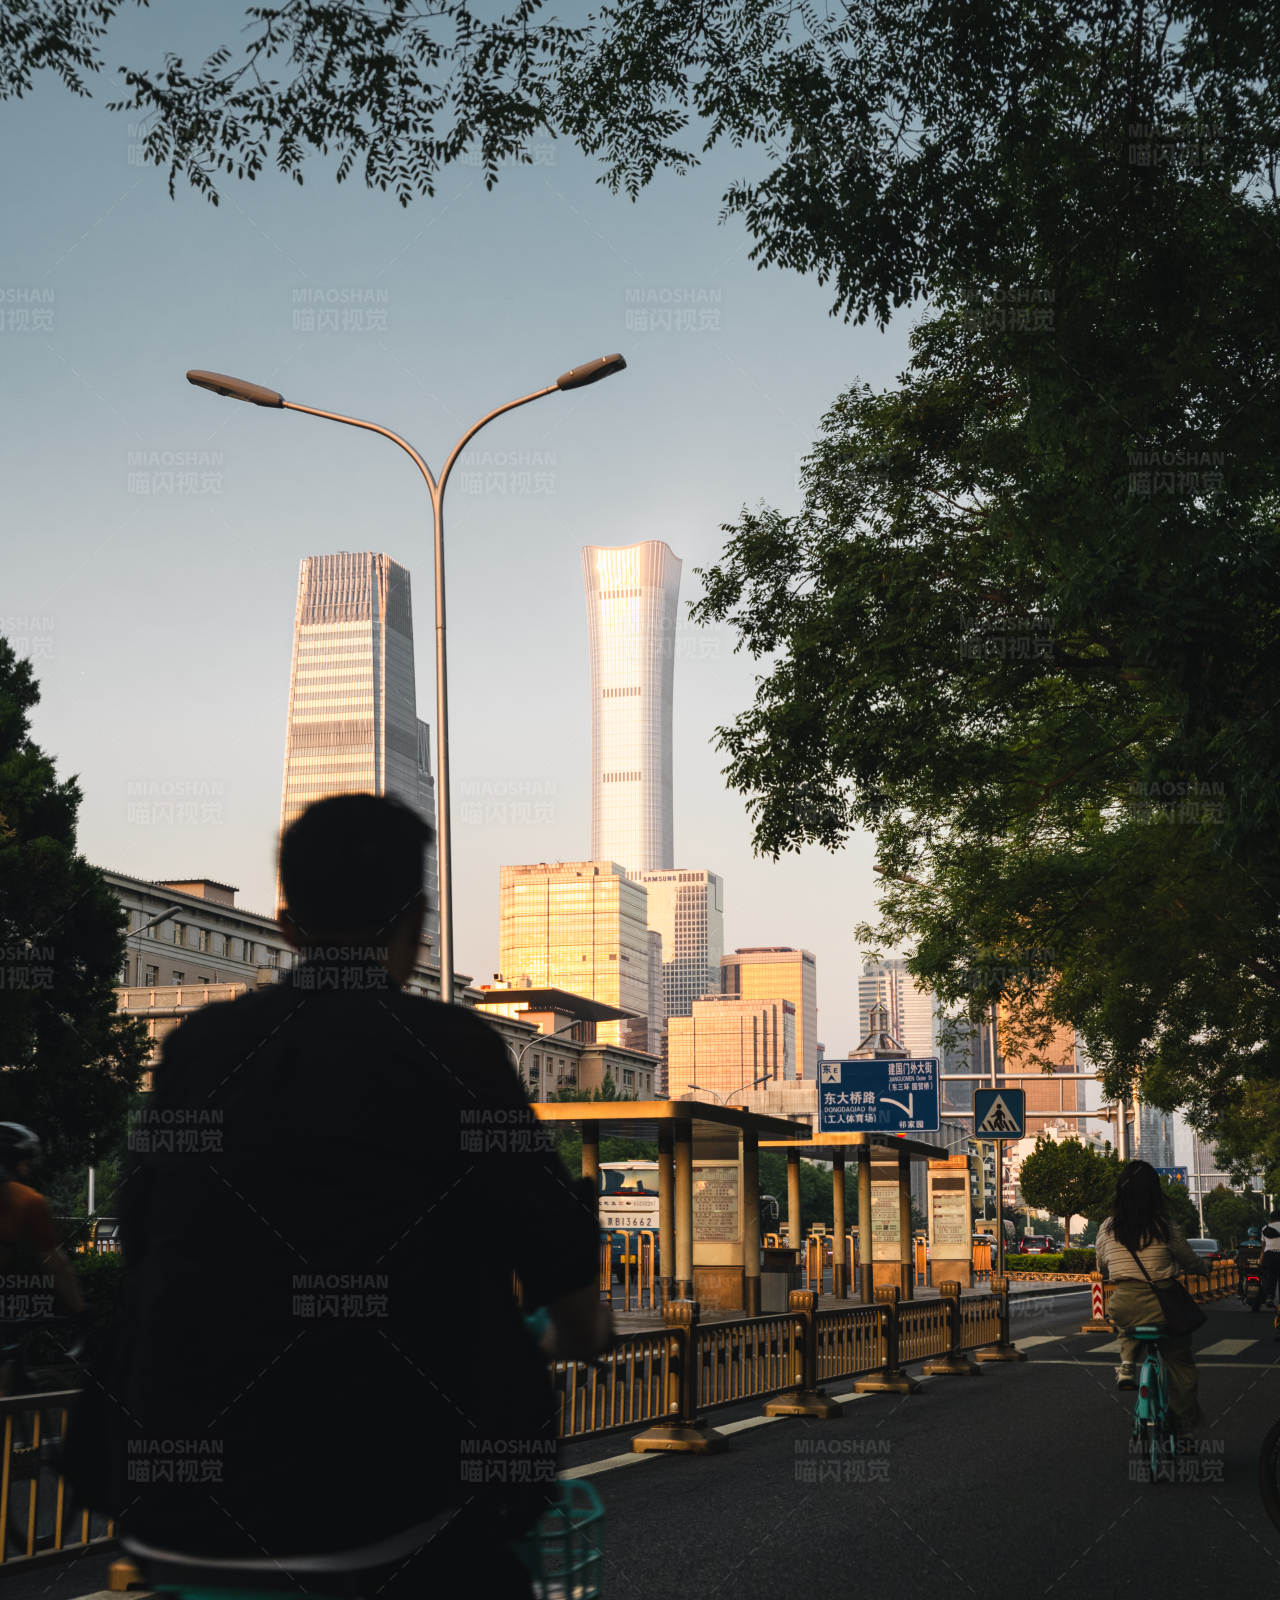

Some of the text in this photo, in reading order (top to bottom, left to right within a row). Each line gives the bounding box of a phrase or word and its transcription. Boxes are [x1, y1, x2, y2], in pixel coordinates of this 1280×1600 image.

[643, 875, 677, 883] SAMSUNG
[822, 1065, 831, 1074] 东
[888, 1062, 932, 1075] 建国门外大街
[824, 1091, 876, 1105] 东大桥路
[824, 1113, 877, 1124] (工人体育场)
